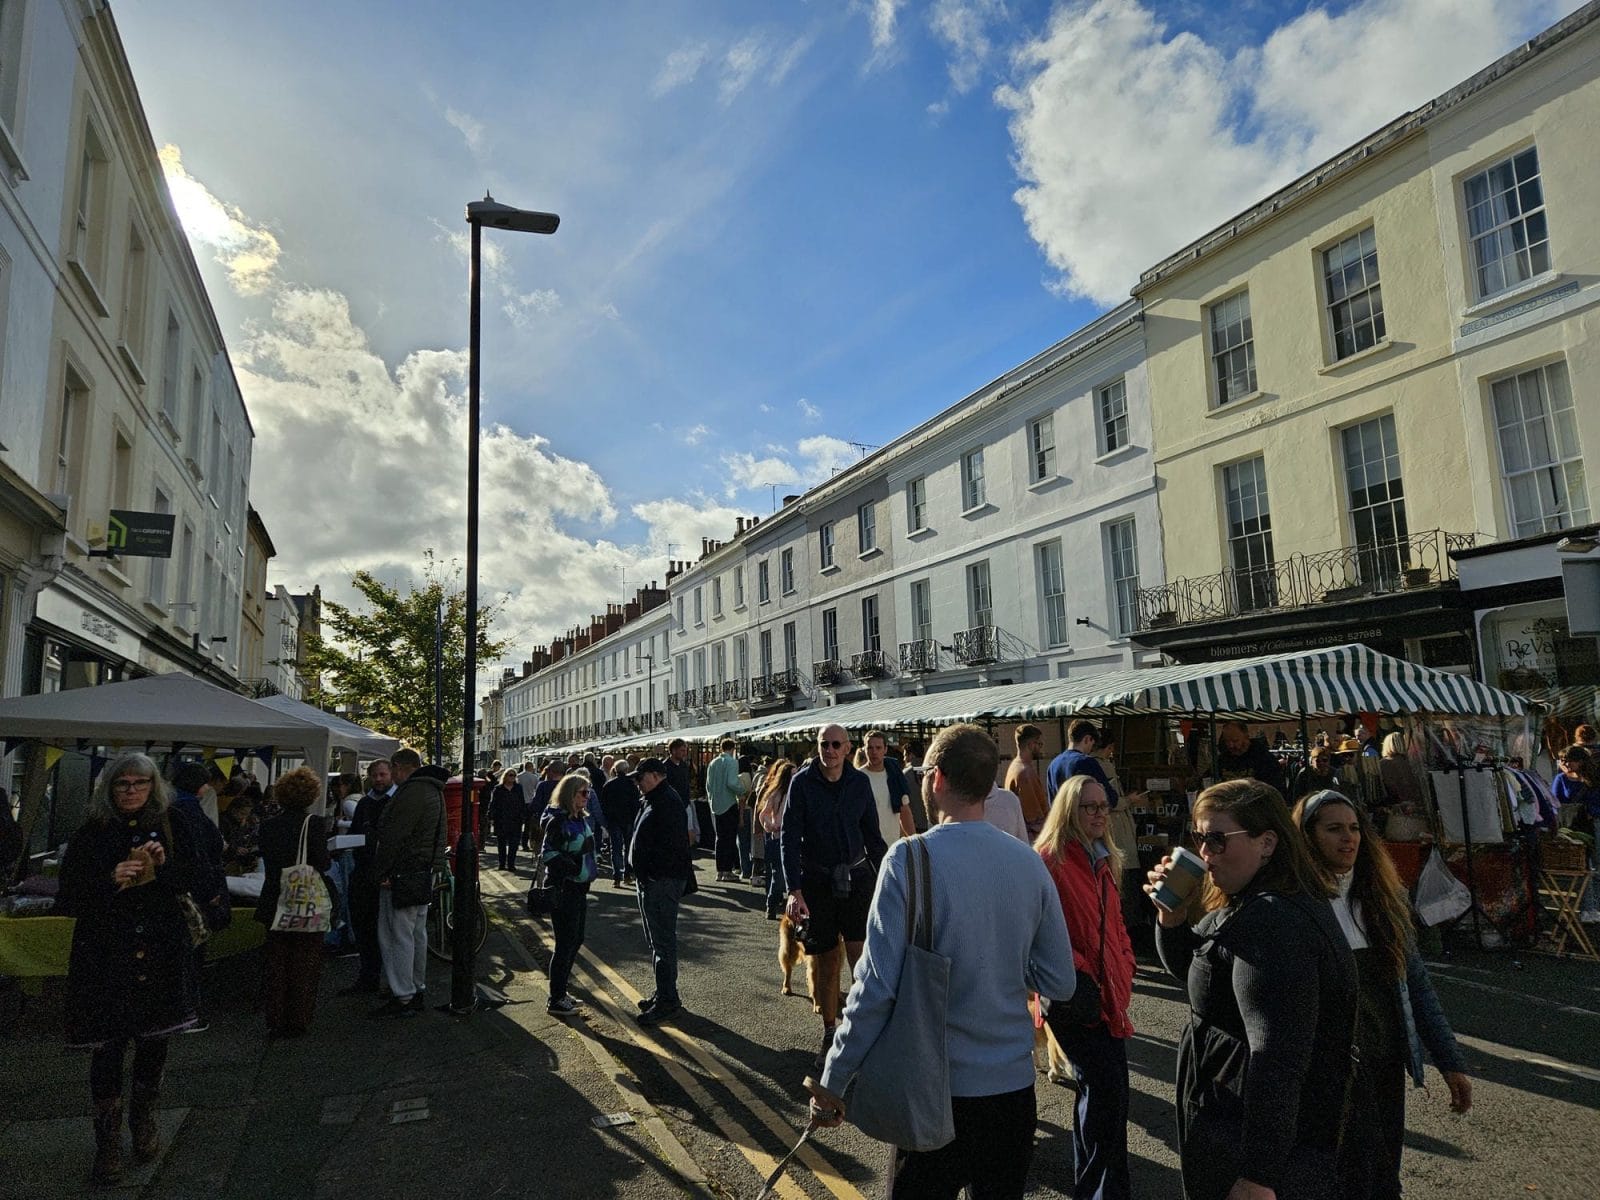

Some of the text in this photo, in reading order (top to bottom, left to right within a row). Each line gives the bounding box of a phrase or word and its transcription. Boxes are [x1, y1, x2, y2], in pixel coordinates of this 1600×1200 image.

[1463, 319, 1489, 333] GREAT
[1210, 643, 1258, 657] bloomers
[1318, 634, 1344, 644] 01242
[1505, 638, 1554, 658] ReVa
[285, 900, 316, 916] STR
